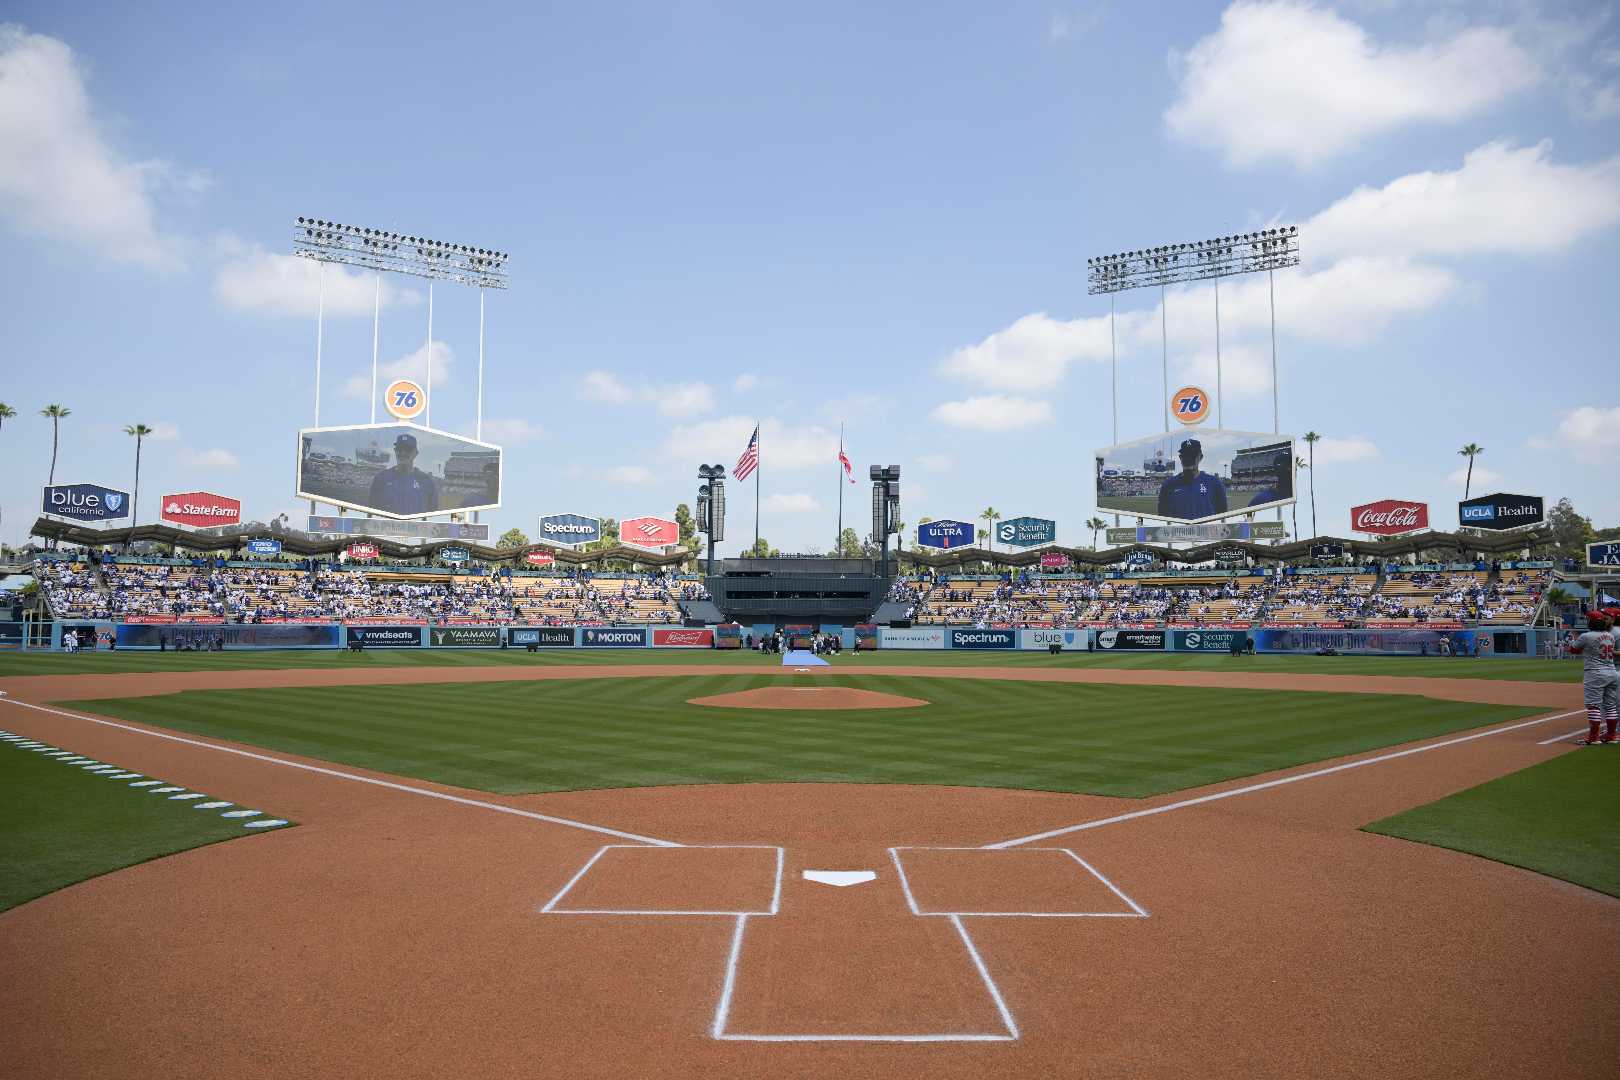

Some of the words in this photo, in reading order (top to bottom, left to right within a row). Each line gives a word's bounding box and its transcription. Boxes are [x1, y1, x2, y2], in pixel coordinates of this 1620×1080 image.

[394, 391, 417, 408] 76
[1179, 395, 1202, 412] 76
[51, 489, 99, 507] blue
[58, 506, 104, 516] california
[1464, 508, 1491, 517] UCLA
[1497, 505, 1537, 516] Health
[544, 522, 592, 534] Spectrum
[929, 528, 963, 536] ULTRA
[1018, 523, 1049, 532] Security
[1019, 532, 1046, 540] Benefit
[518, 632, 537, 641] UCLA
[541, 633, 570, 641] Health
[598, 633, 641, 642] MORTON
[954, 632, 1006, 645] Spectrum
[1034, 631, 1061, 643] blue
[1202, 633, 1233, 642] Security
[1203, 641, 1231, 649] Benefit
